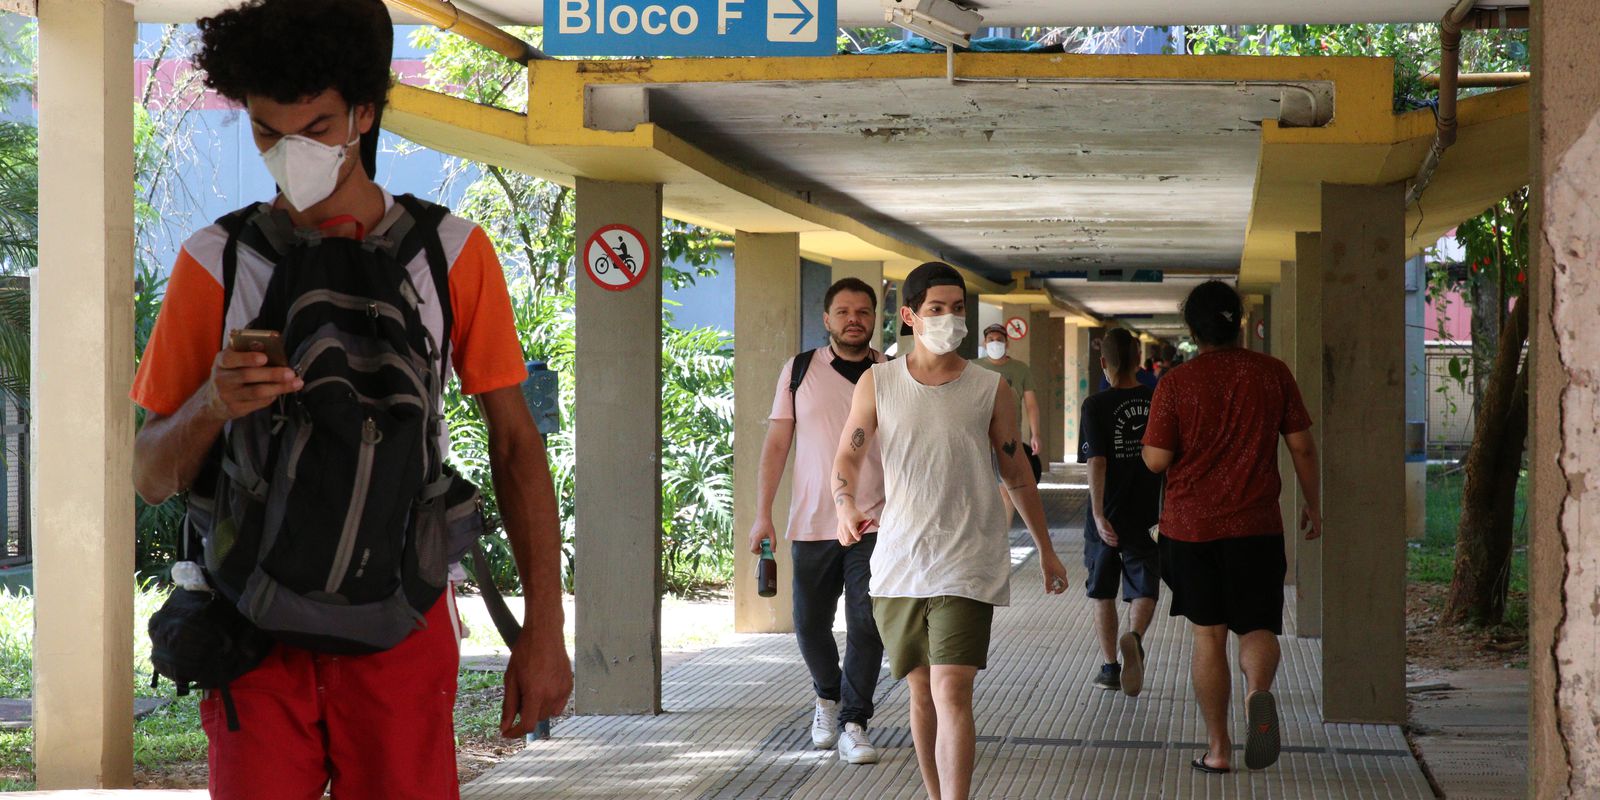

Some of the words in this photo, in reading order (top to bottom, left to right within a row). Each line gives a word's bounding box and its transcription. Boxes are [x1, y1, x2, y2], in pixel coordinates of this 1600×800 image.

[559, 0, 698, 35] Bloco
[717, 0, 745, 35] F
[1114, 417, 1125, 451] TRIPLE
[1124, 405, 1149, 418] DOUB
